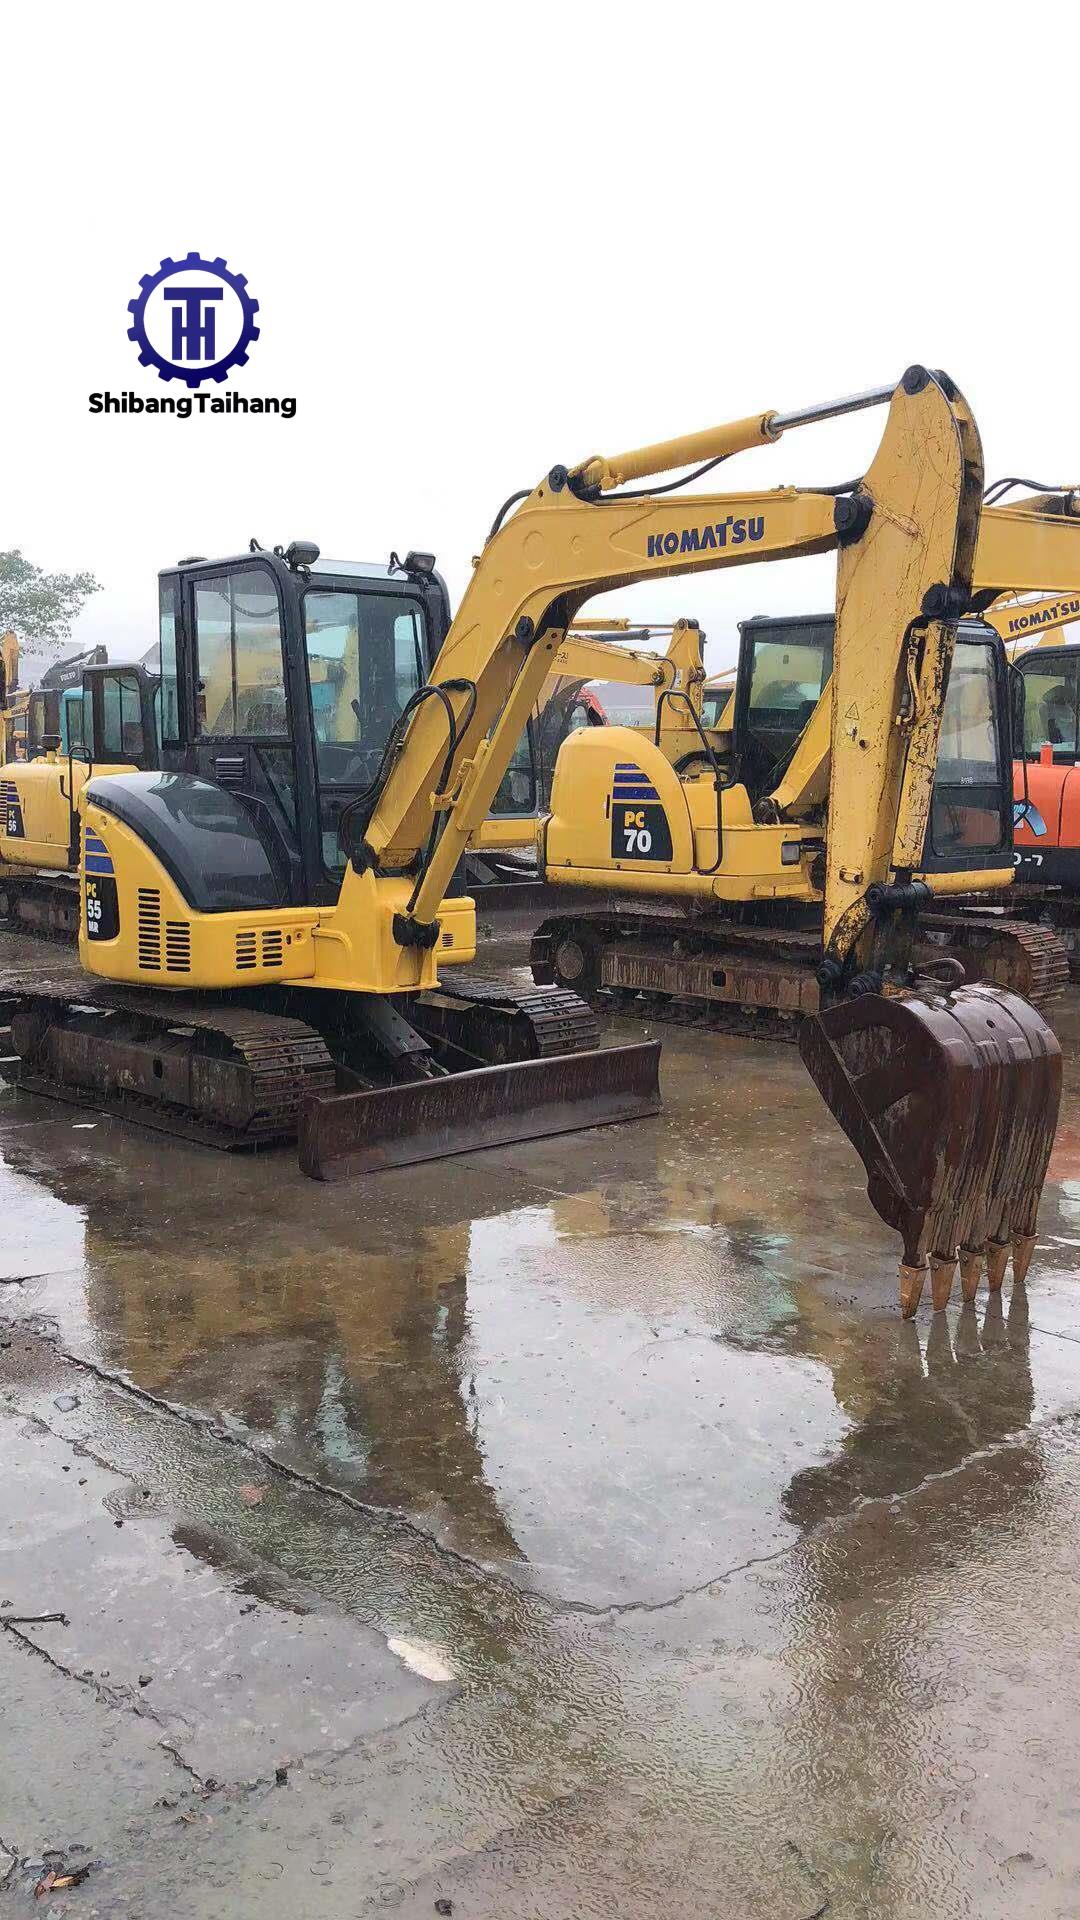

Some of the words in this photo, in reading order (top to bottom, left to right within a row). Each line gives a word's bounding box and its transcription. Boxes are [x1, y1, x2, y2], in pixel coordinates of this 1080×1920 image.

[647, 515, 765, 558] KOMATSU
[1008, 600, 1080, 633] KOMATSU
[8, 820, 17, 832] 56
[624, 811, 645, 828] PC
[623, 829, 652, 853] 70
[86, 882, 97, 898] PC
[87, 898, 102, 920] 55
